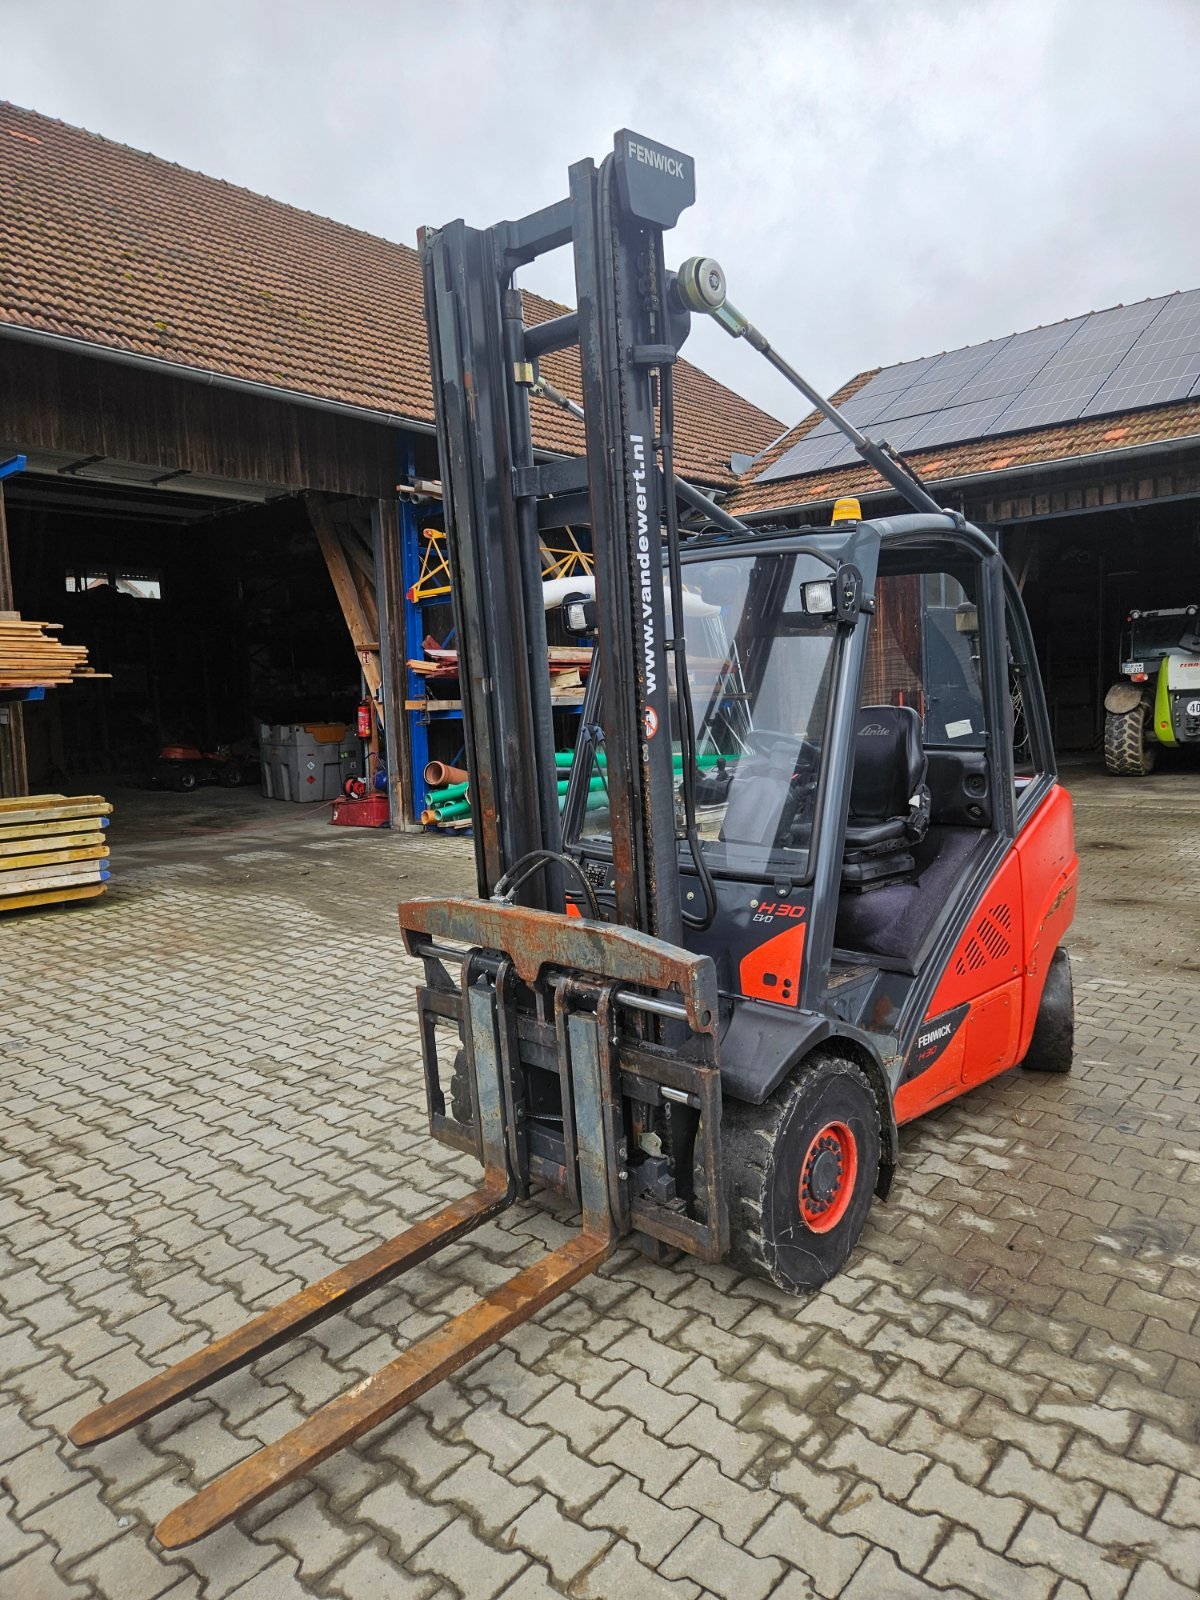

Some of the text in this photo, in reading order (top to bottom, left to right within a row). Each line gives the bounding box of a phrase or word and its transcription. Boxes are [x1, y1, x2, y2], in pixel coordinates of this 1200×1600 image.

[628, 141, 684, 179] FENWICK
[630, 434, 657, 695] www.vandewert.nl
[857, 723, 890, 736] Linde
[752, 913, 774, 923] EVO
[918, 1023, 951, 1048] FENWICK
